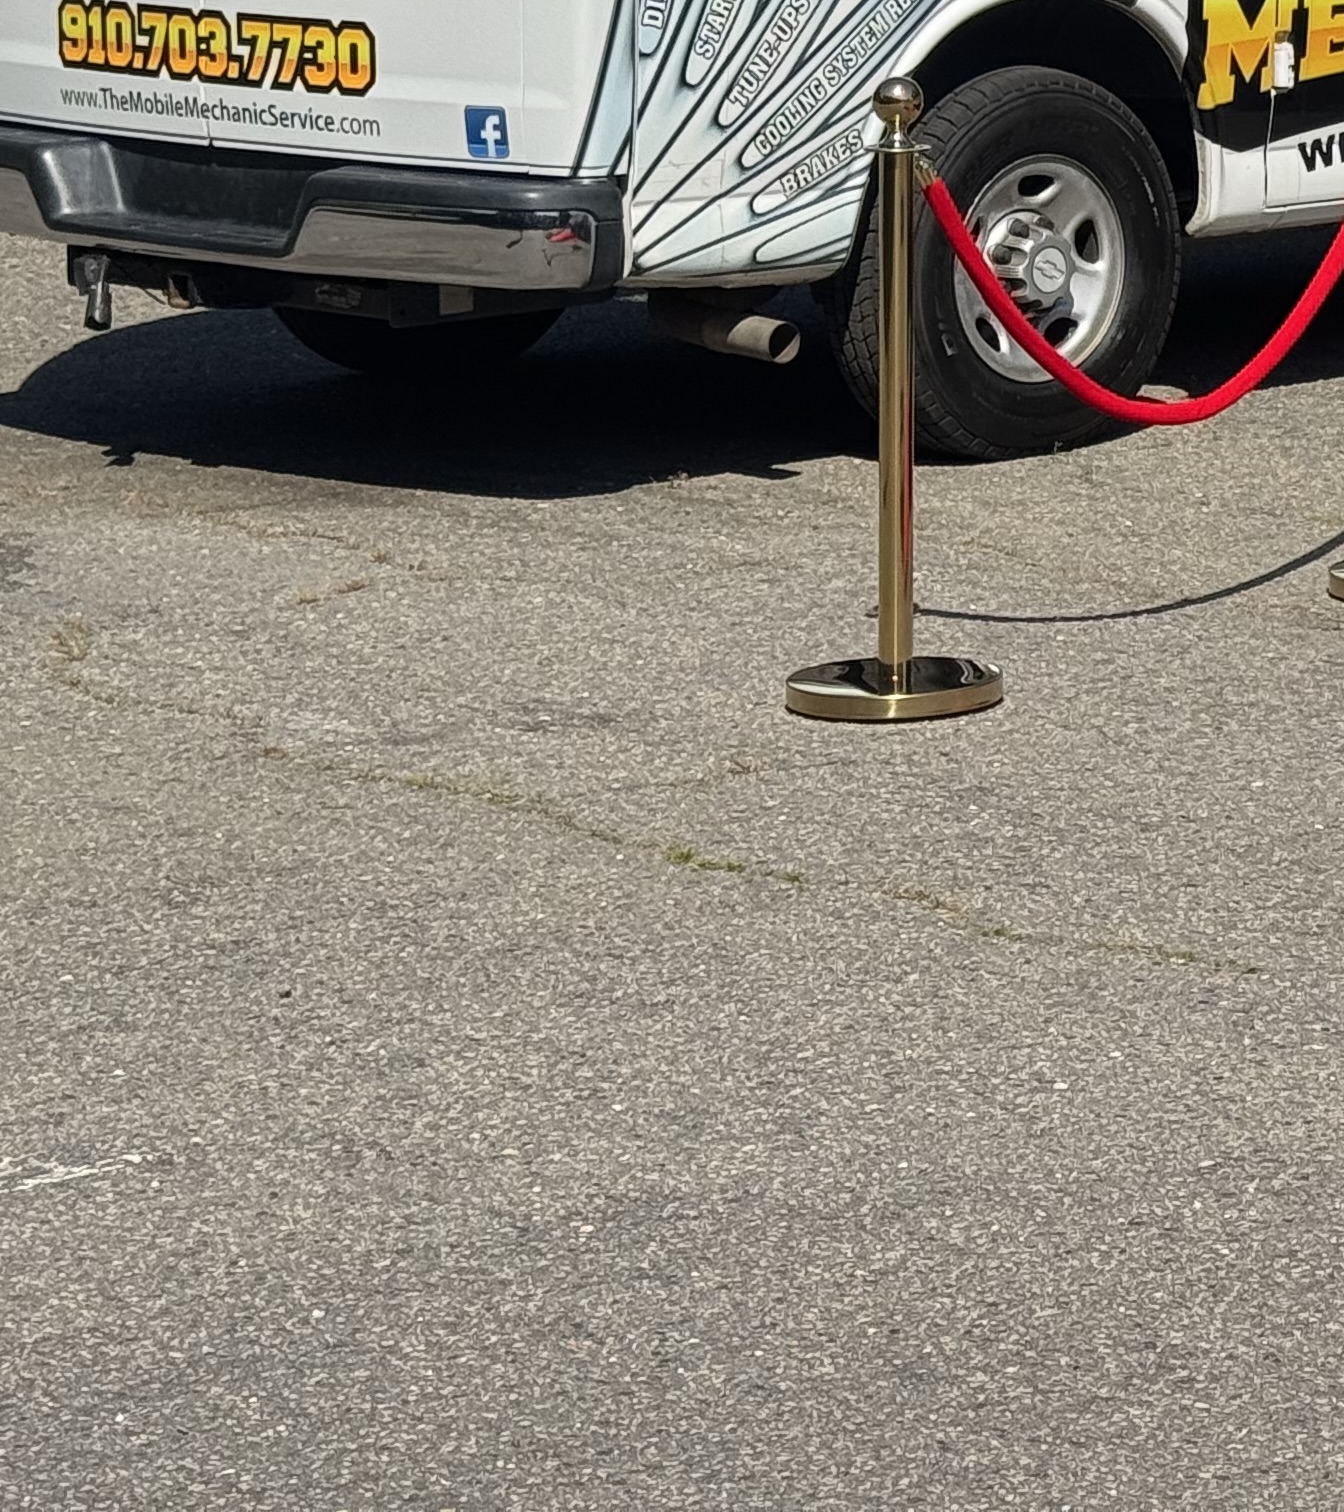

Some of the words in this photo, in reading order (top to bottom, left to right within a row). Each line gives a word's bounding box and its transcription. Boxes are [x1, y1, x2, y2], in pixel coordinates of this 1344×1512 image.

[60, 1, 373, 92] 910.703.7730
[754, 74, 827, 157] COOLING
[825, 15, 890, 88] SYSTEM
[61, 88, 381, 137] www.TheMobileMechanicService.com
[780, 128, 863, 197] BRAKES
